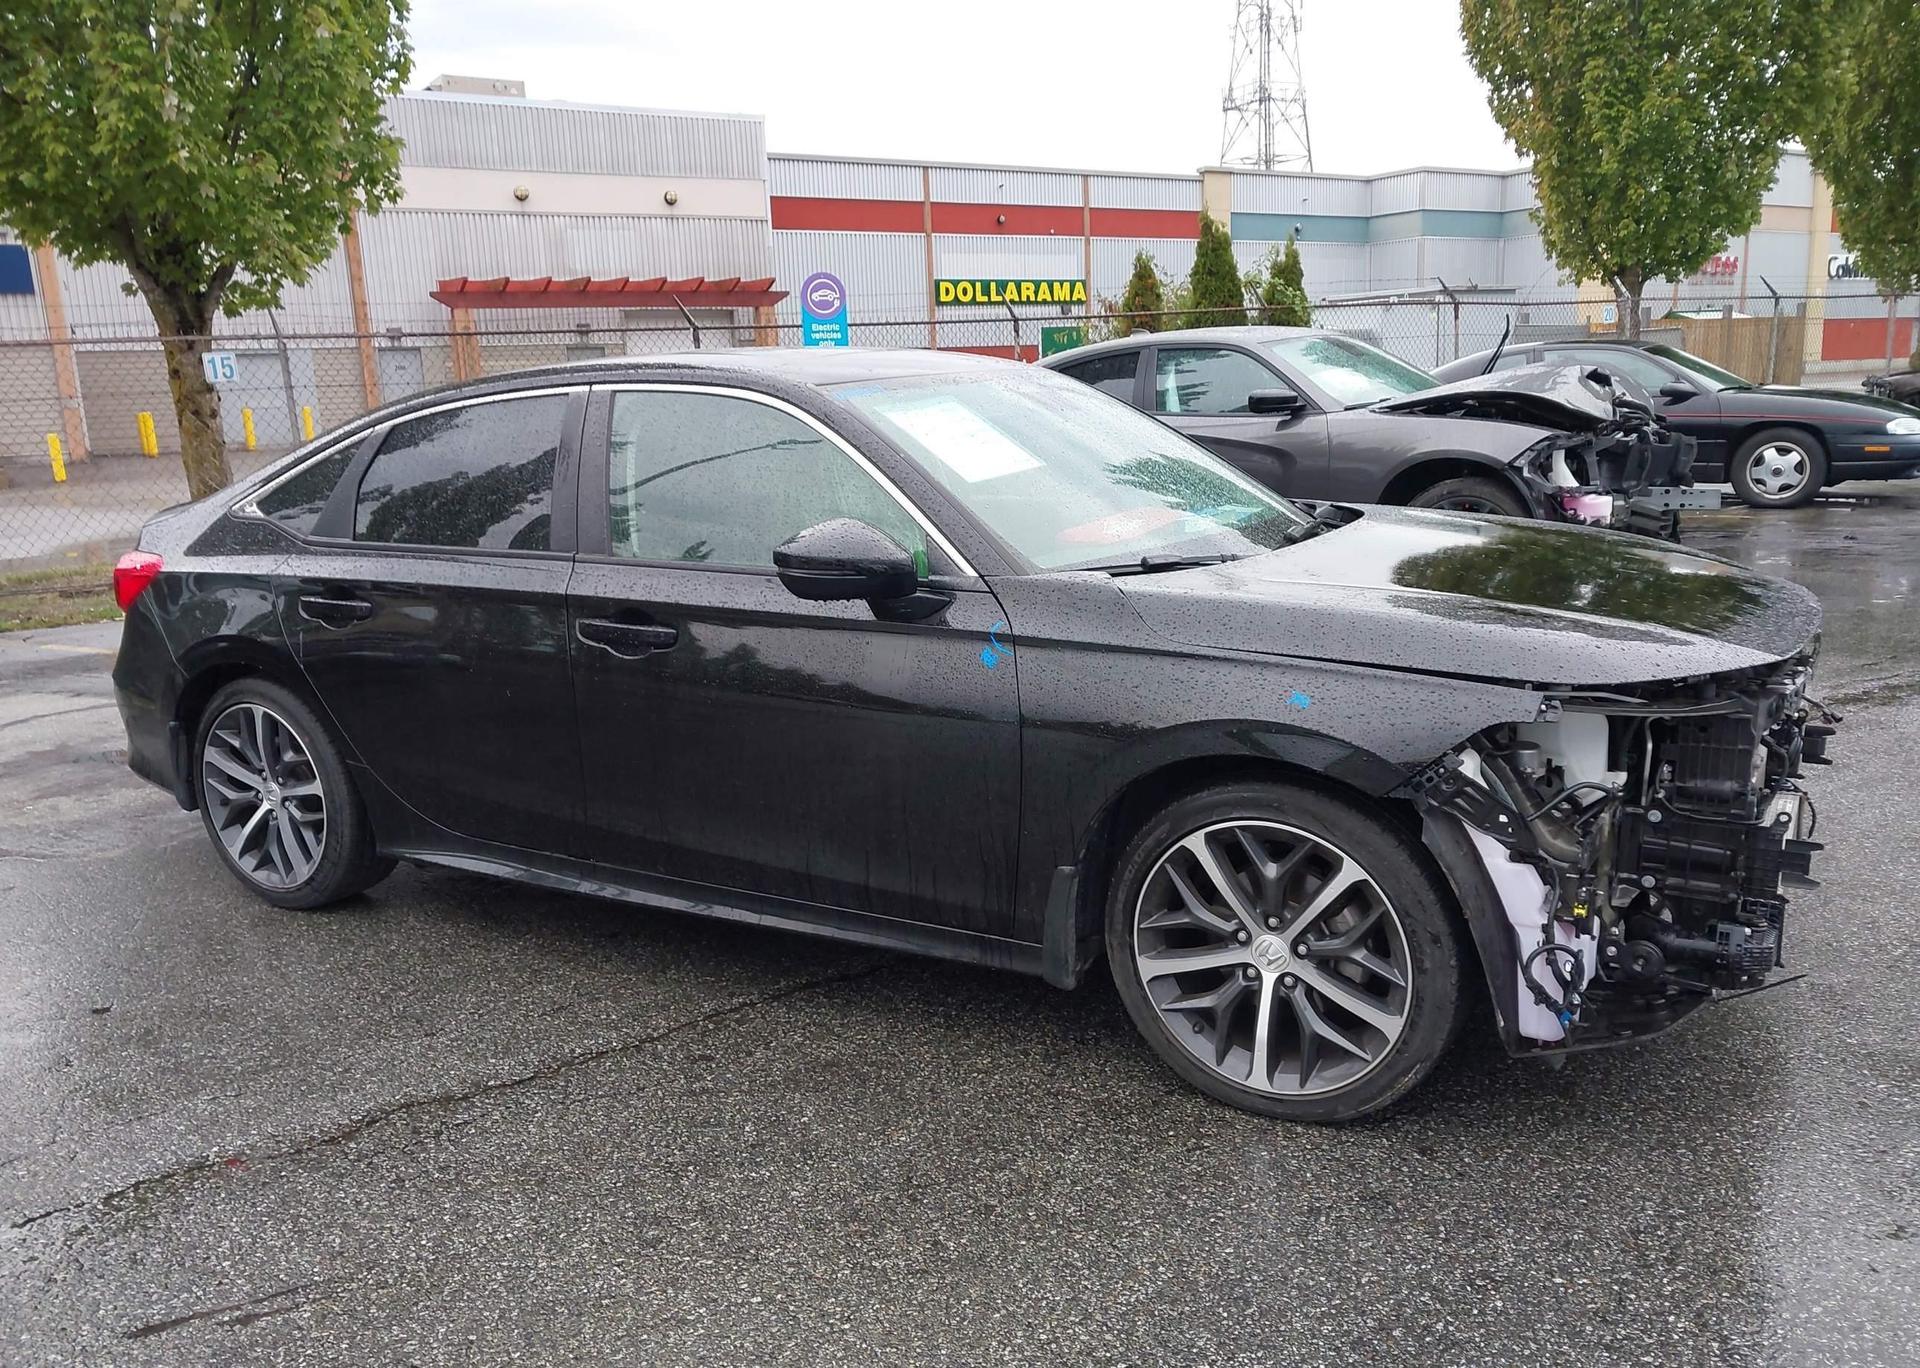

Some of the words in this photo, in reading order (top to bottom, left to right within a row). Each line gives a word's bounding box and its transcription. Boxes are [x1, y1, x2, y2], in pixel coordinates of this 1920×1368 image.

[939, 281, 1087, 303] DOLLARAMA
[1604, 307, 1614, 322] 20
[811, 323, 840, 331] Electric
[811, 331, 842, 340] vehicles
[207, 356, 235, 379] 15
